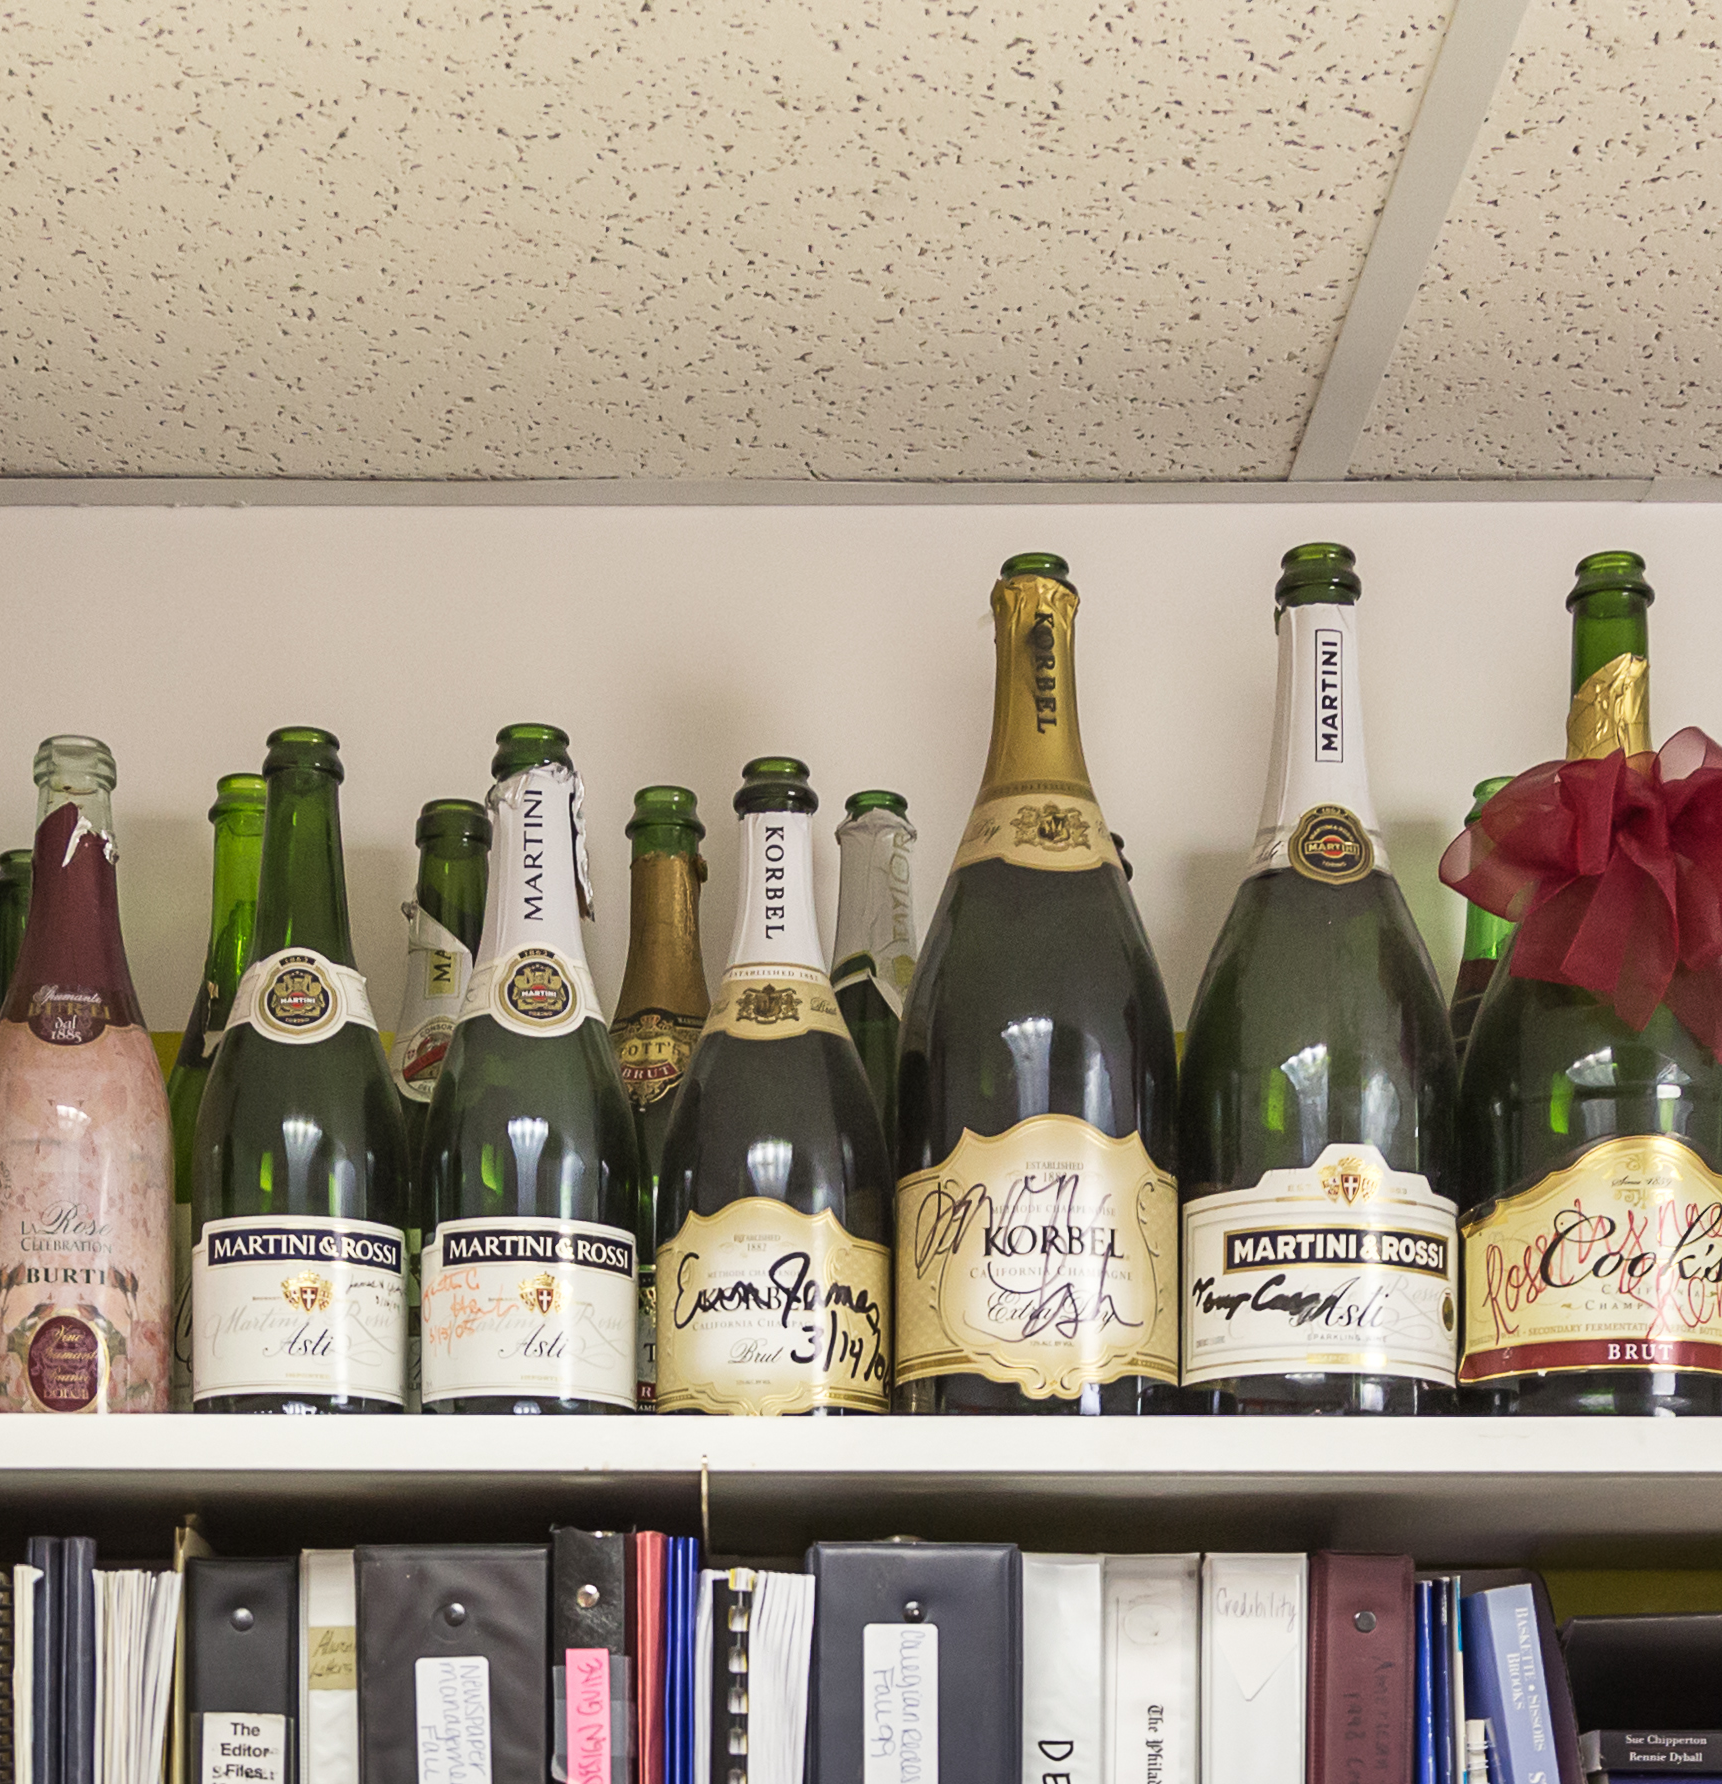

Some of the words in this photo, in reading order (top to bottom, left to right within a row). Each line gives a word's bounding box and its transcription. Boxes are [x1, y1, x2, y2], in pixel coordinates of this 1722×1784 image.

[1034, 610, 1058, 735] KORBEL
[1321, 640, 1339, 753] MARTINI
[523, 789, 544, 922] MARTINI
[765, 824, 787, 942] KORBEL
[214, 1236, 320, 1261] MARTINI
[340, 1238, 397, 1266] ROSSI
[983, 1226, 1127, 1260] KORBEL
[1233, 1233, 1360, 1263] MARTINI
[1380, 1236, 1445, 1270] ROSSI
[26, 1266, 109, 1286] BURTI
[1607, 1342, 1674, 1361] BRUT
[230, 1722, 260, 1736] The
[1146, 1704, 1163, 1737] The
[220, 1742, 269, 1758] Editor
